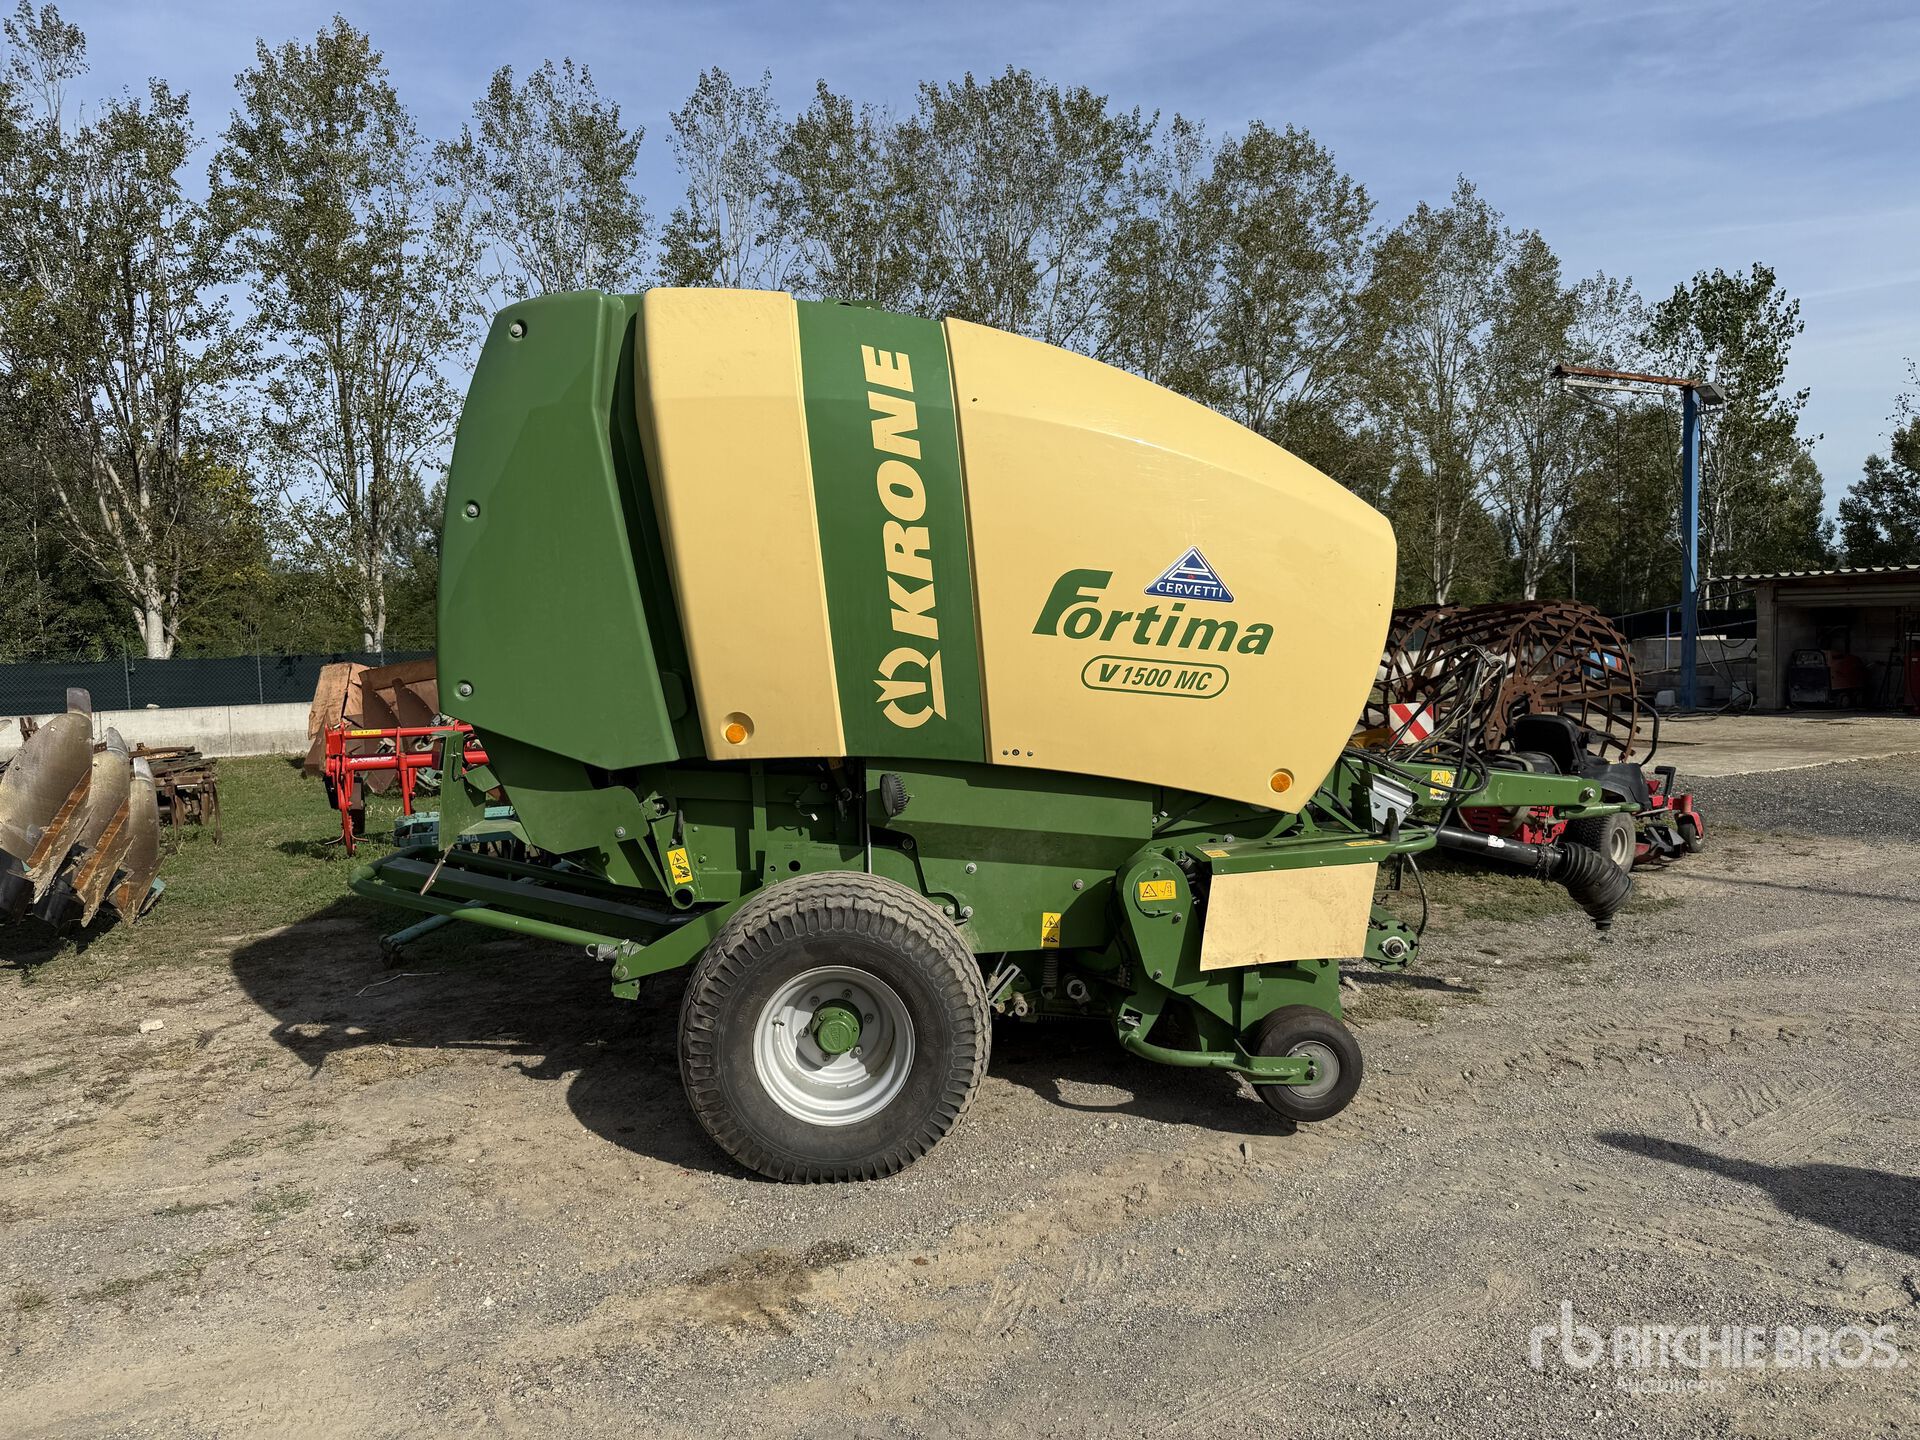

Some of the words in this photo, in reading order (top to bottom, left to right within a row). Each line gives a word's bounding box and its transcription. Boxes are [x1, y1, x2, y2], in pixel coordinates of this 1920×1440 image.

[861, 344, 939, 640] KRONE
[1031, 568, 1275, 656] Fortima
[1156, 581, 1223, 598] CERVETTI
[1099, 663, 1121, 683] V
[1122, 666, 1172, 688] 1500
[1173, 670, 1213, 691] MC
